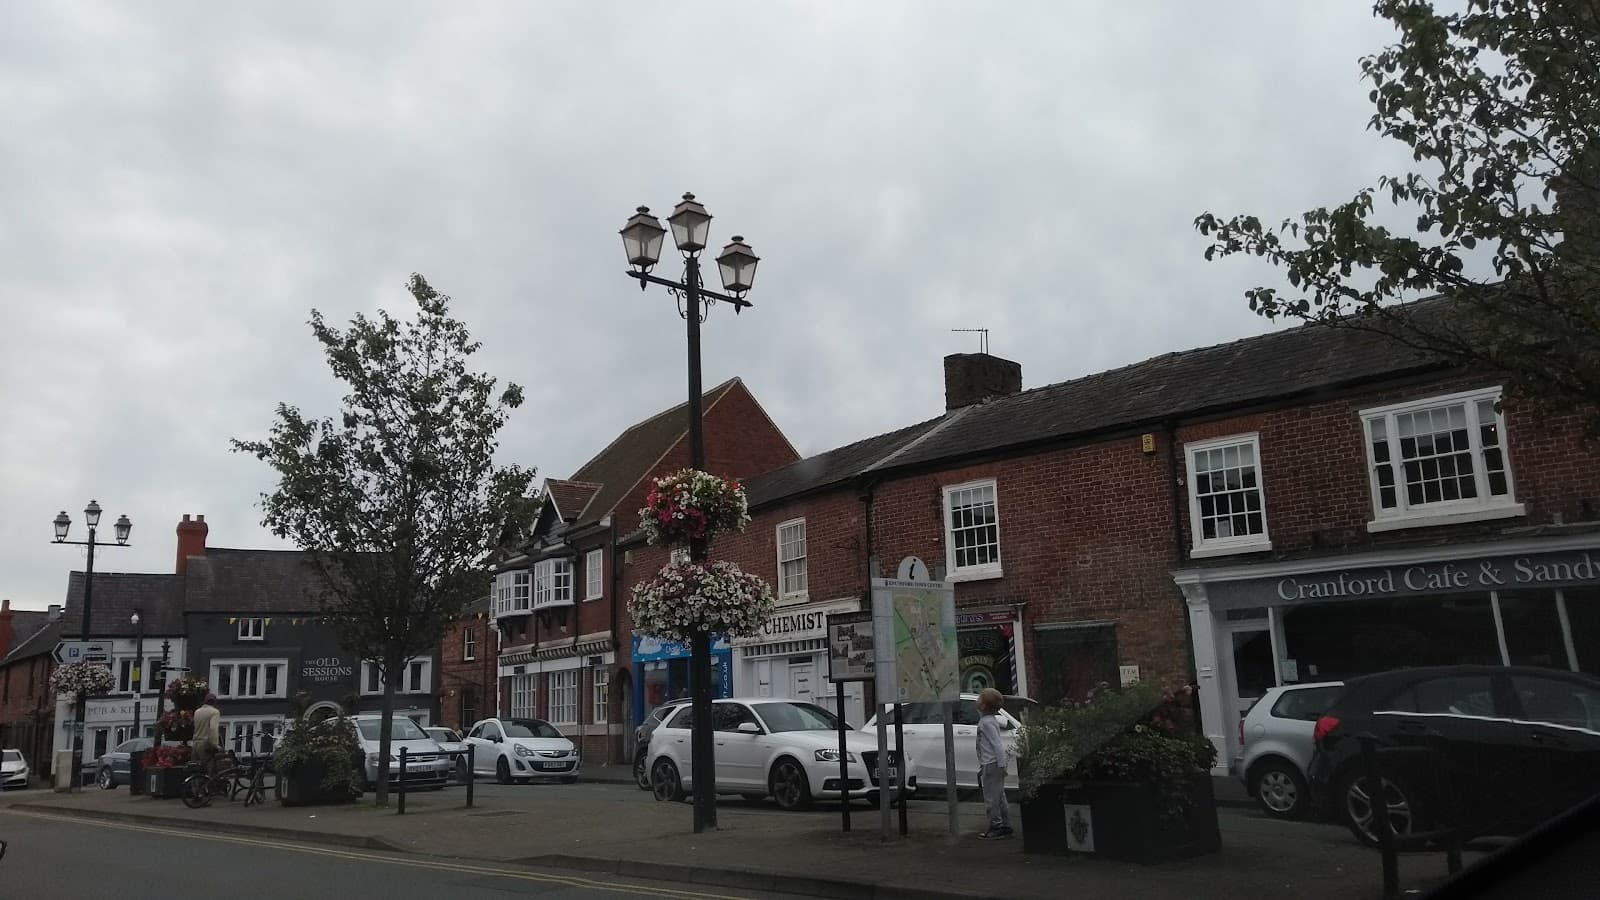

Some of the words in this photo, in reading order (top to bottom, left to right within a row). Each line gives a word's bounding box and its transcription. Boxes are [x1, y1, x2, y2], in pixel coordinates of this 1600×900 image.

[1276, 569, 1397, 601] Cranford
[1403, 566, 1470, 591] Cafe
[1479, 560, 1506, 586] &
[763, 610, 825, 636] CHEMIST
[316, 657, 341, 667] OLD
[302, 666, 353, 677] SESSIONS
